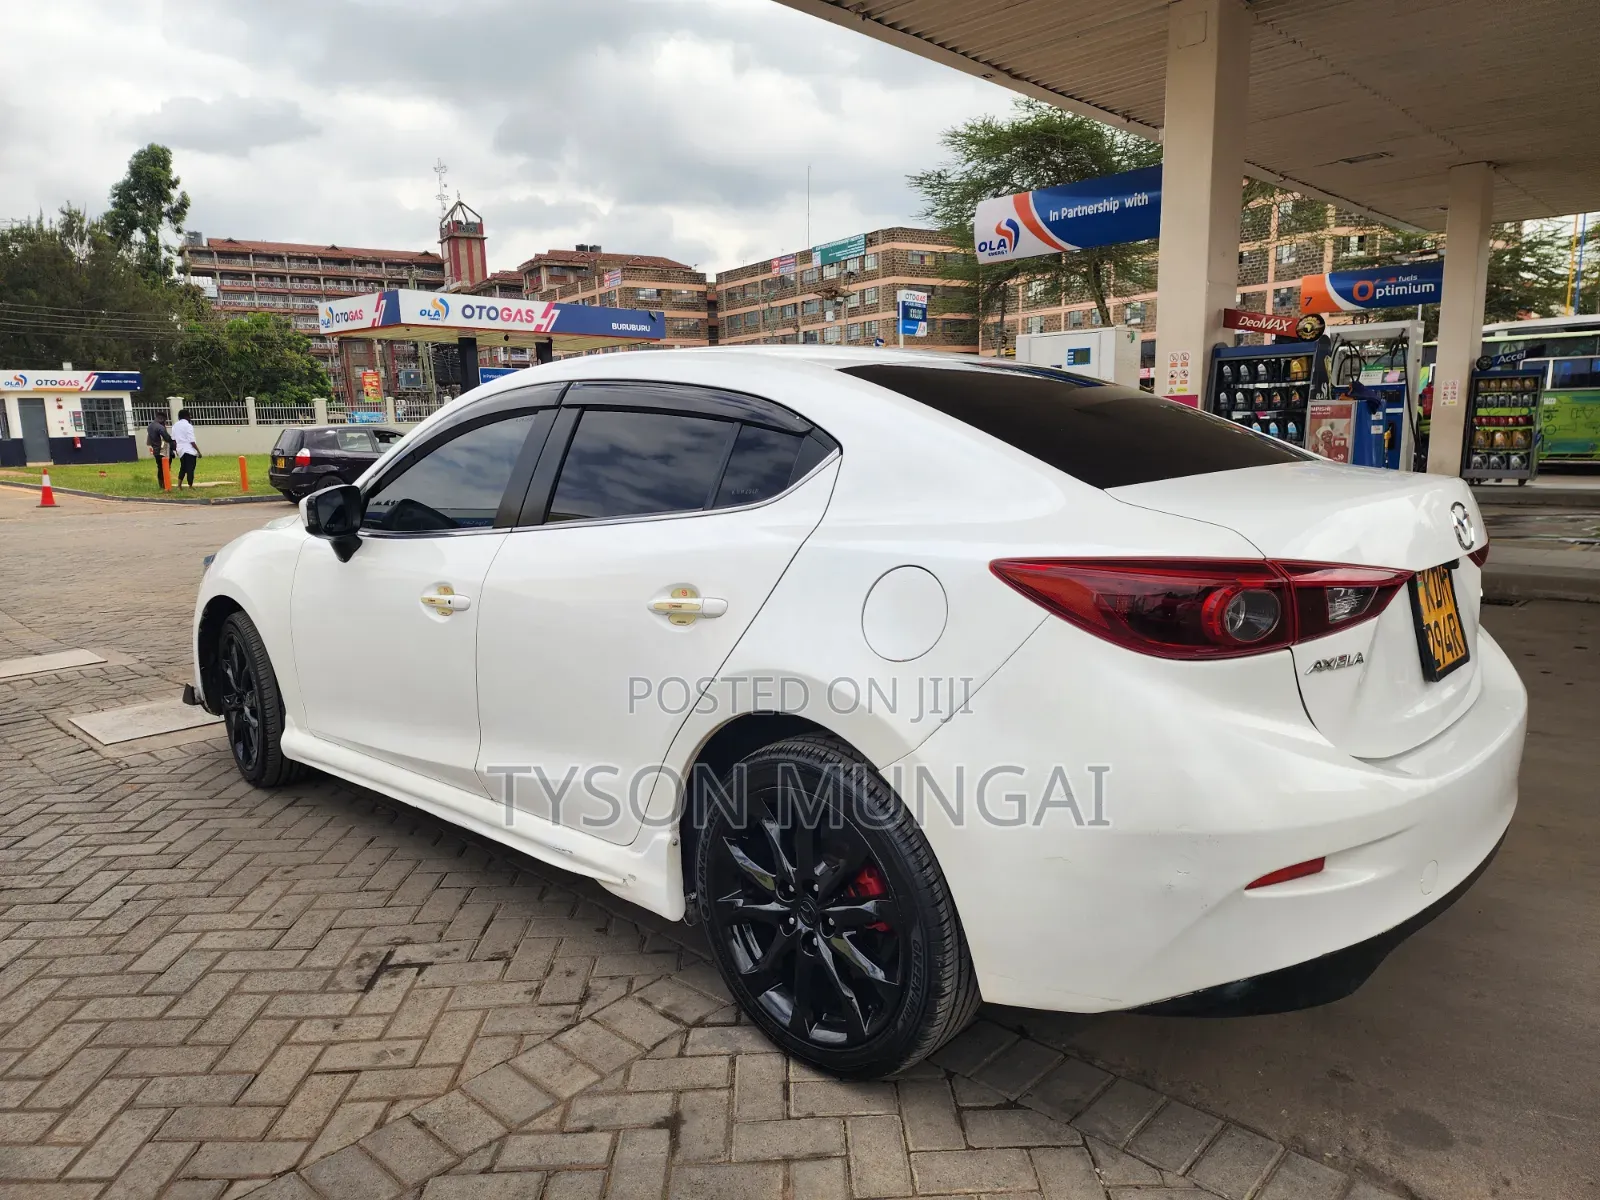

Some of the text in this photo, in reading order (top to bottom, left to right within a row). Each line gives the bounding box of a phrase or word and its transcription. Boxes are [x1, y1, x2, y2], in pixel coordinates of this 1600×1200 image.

[1050, 193, 1149, 222] In Partnership with
[978, 238, 1007, 253] OLA
[1398, 274, 1418, 283] fuels
[1304, 296, 1313, 307] 7
[335, 309, 364, 323] OTOGAS
[420, 304, 535, 324] OLA OTOGAS
[611, 322, 651, 332] BURUBURU
[1238, 316, 1293, 332] DeoMAX
[1497, 350, 1527, 365] Accel
[35, 379, 80, 387] OTOGAS
[1425, 613, 1464, 669] 294R
[1304, 651, 1365, 676] AXELA
